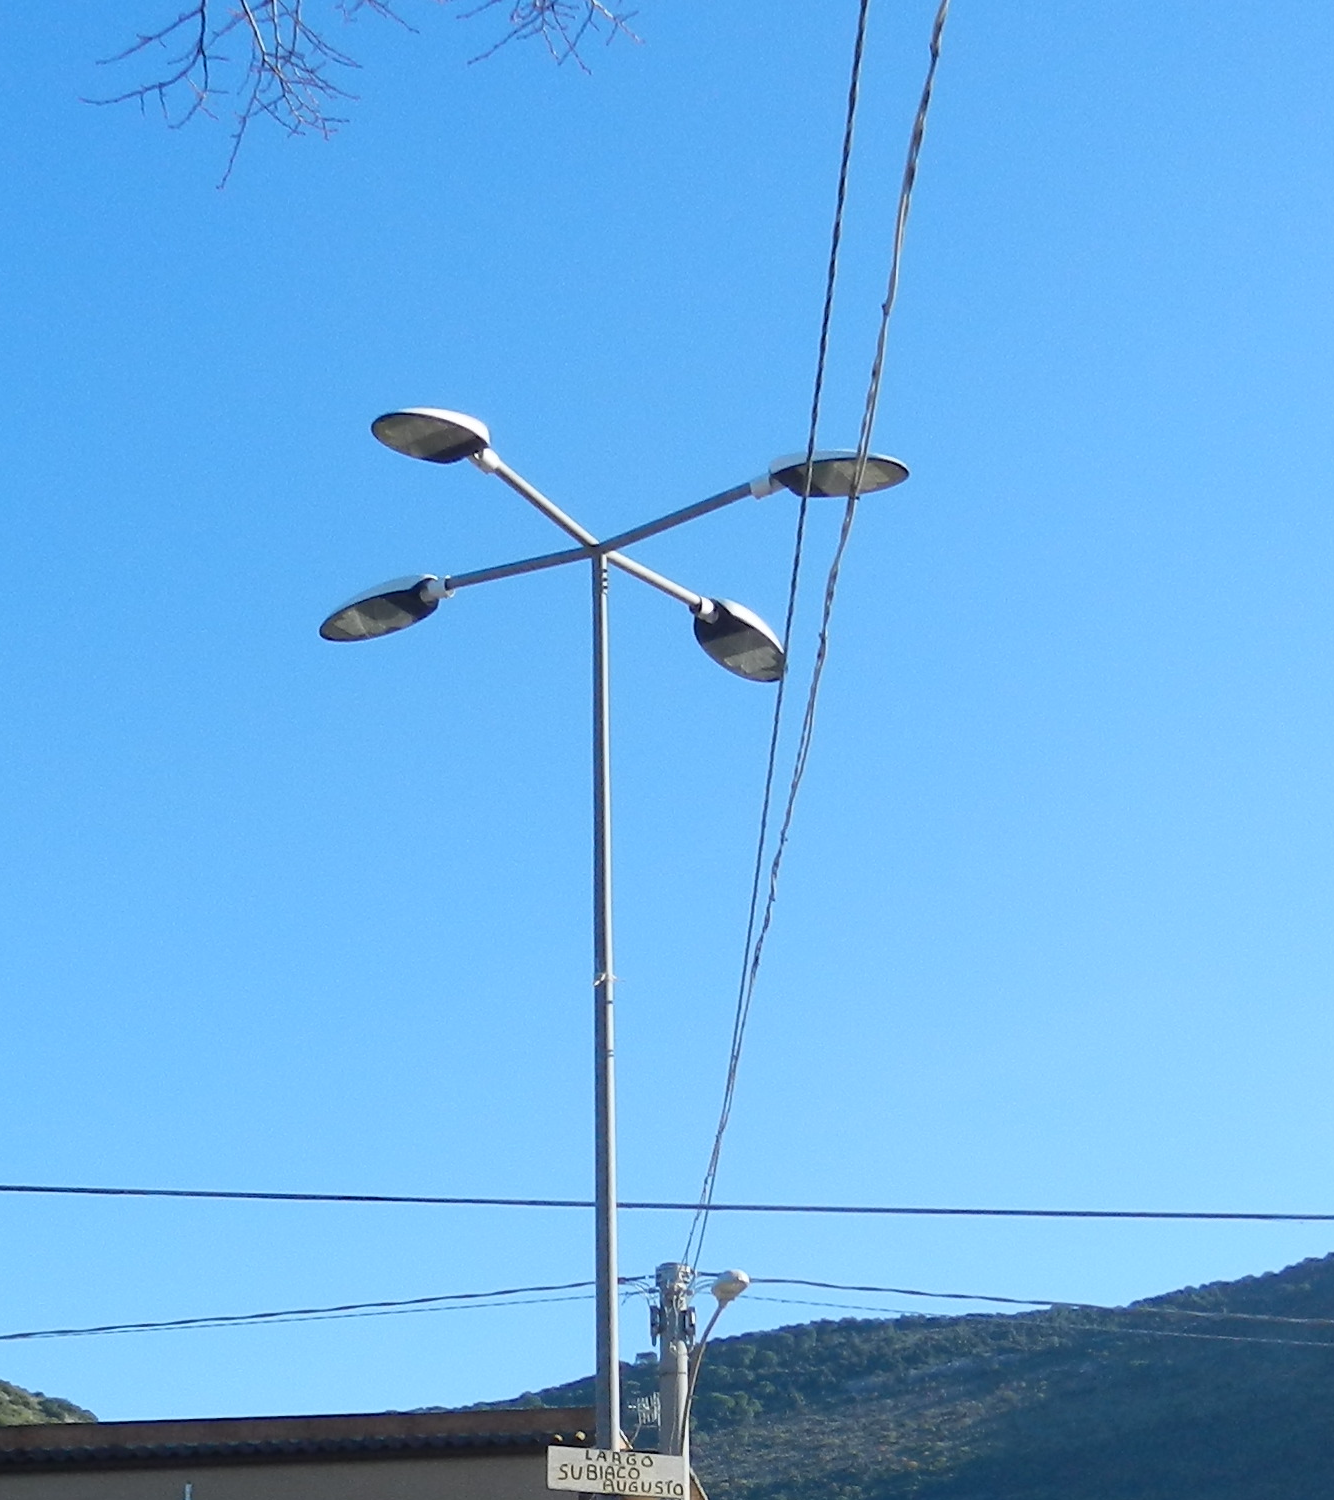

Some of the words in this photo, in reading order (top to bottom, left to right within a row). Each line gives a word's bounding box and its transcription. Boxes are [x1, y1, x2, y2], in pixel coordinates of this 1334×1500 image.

[585, 1449, 653, 1467] LARGO
[558, 1463, 640, 1480] SUBIACO
[603, 1480, 684, 1495] AUGUSTO
